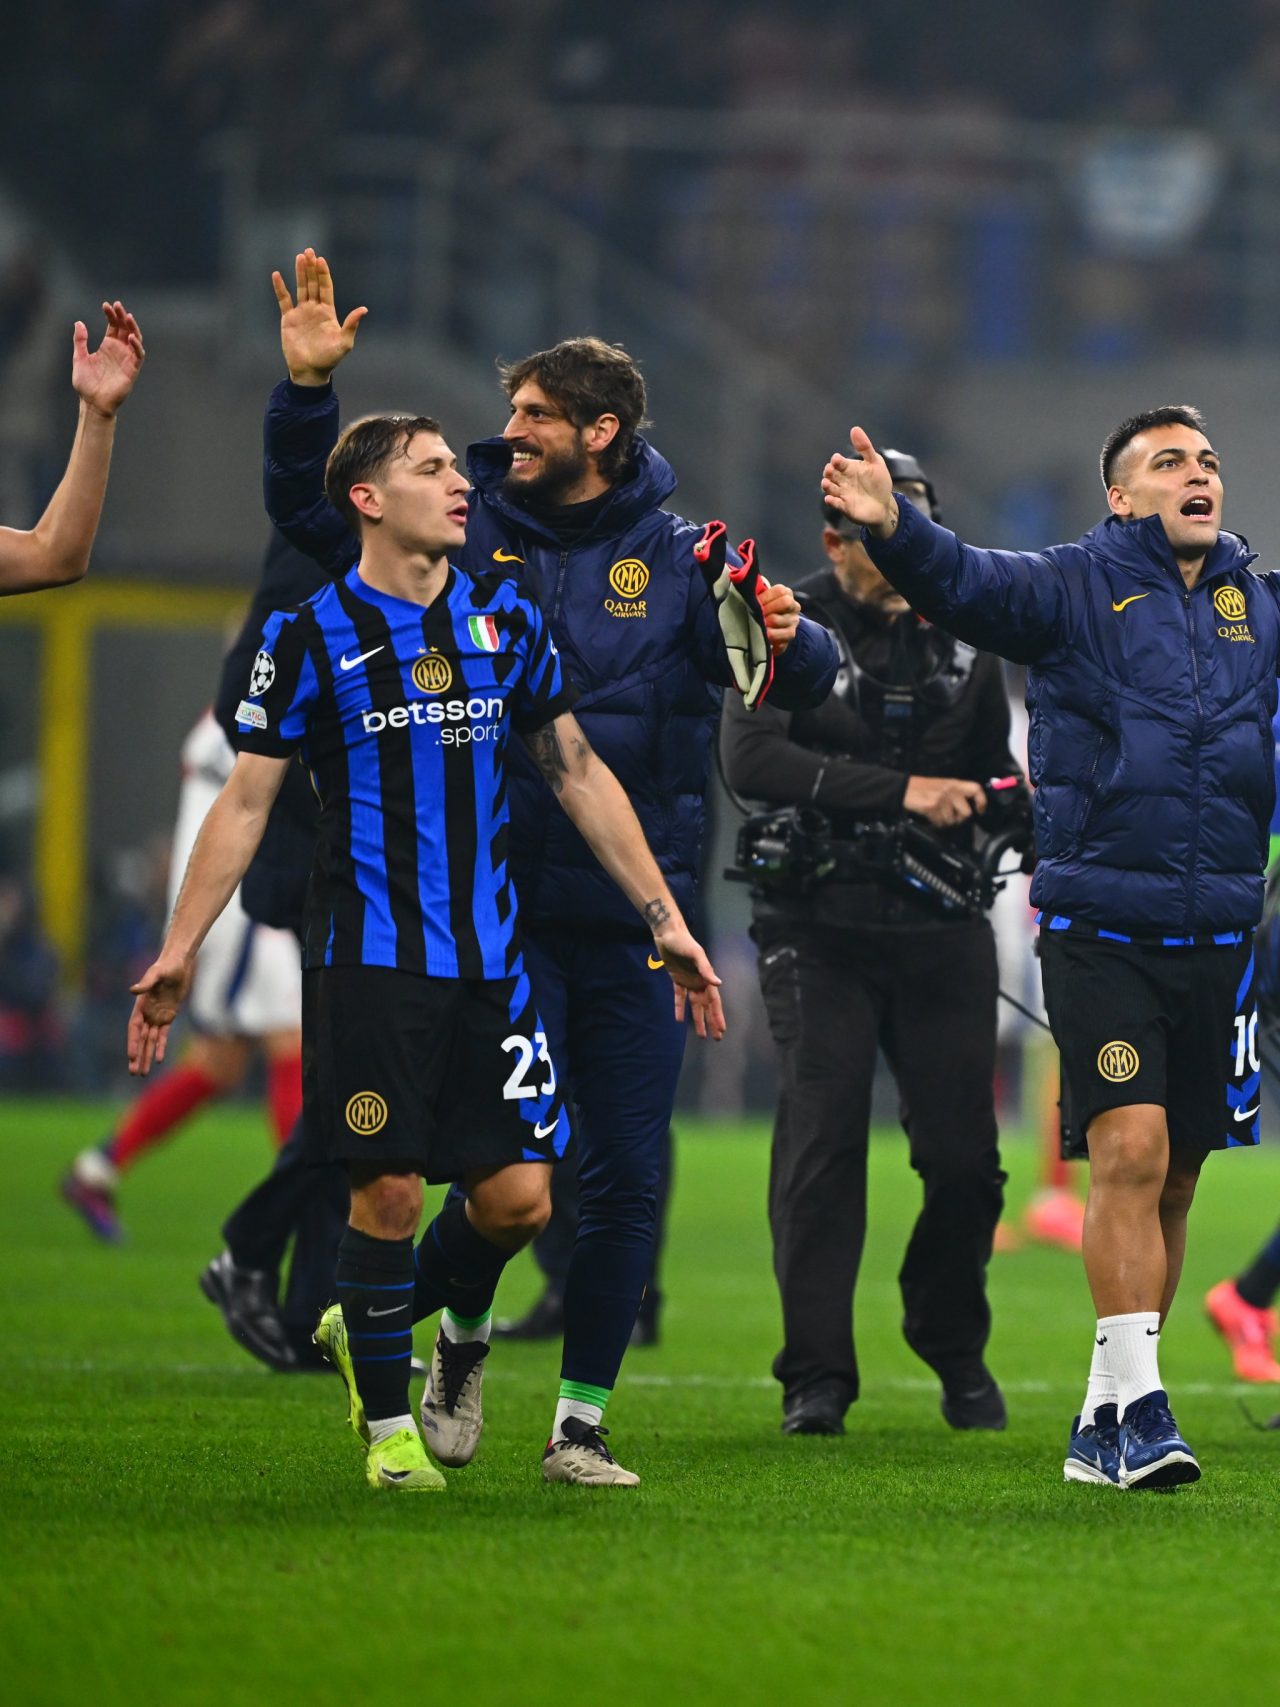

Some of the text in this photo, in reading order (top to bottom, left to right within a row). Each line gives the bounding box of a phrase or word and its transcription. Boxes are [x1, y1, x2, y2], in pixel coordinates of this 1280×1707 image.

[604, 599, 647, 613] QATAR
[612, 610, 647, 619] AIRWAYS
[361, 697, 504, 733] betsson
[434, 722, 500, 748] .sport
[500, 1031, 556, 1100] 23
